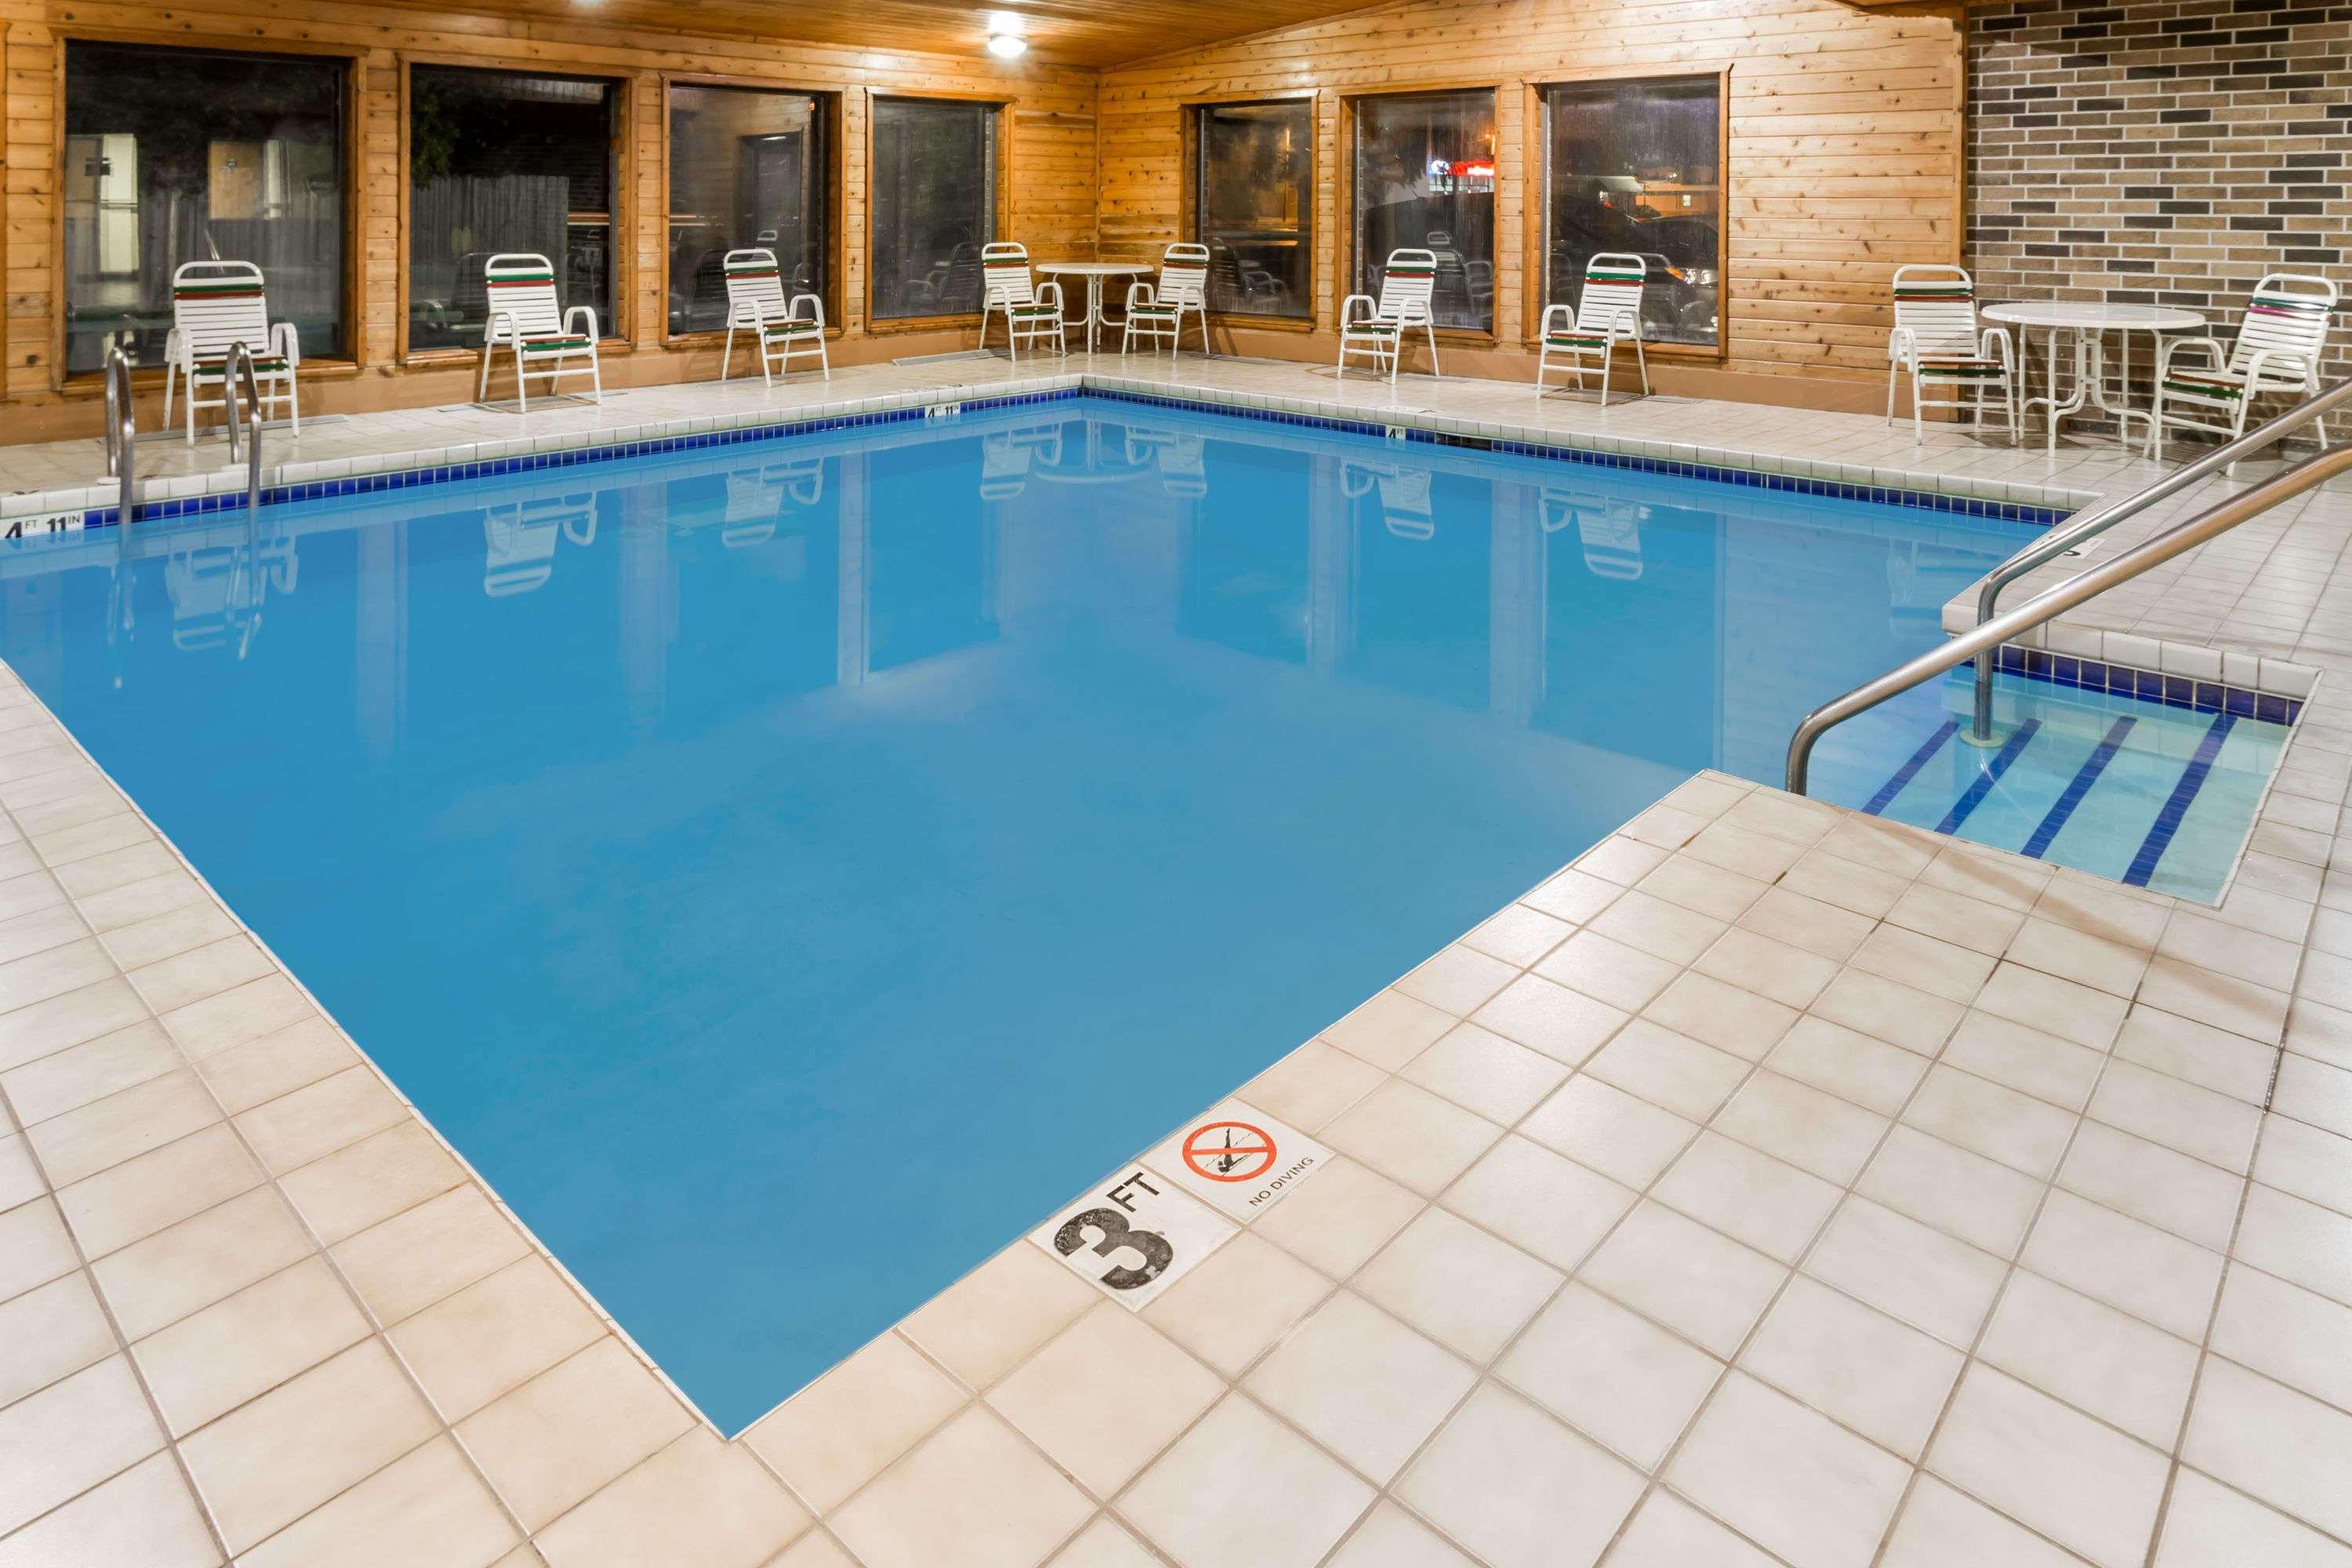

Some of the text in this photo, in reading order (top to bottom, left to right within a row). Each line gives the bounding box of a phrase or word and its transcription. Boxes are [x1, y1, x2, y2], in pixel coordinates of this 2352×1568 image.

[25, 519, 38, 529] FT
[47, 517, 66, 532] 11
[68, 514, 81, 524] IN
[1248, 1156, 1314, 1207] NO DIVING
[1054, 1171, 1174, 1290] 3 FT
